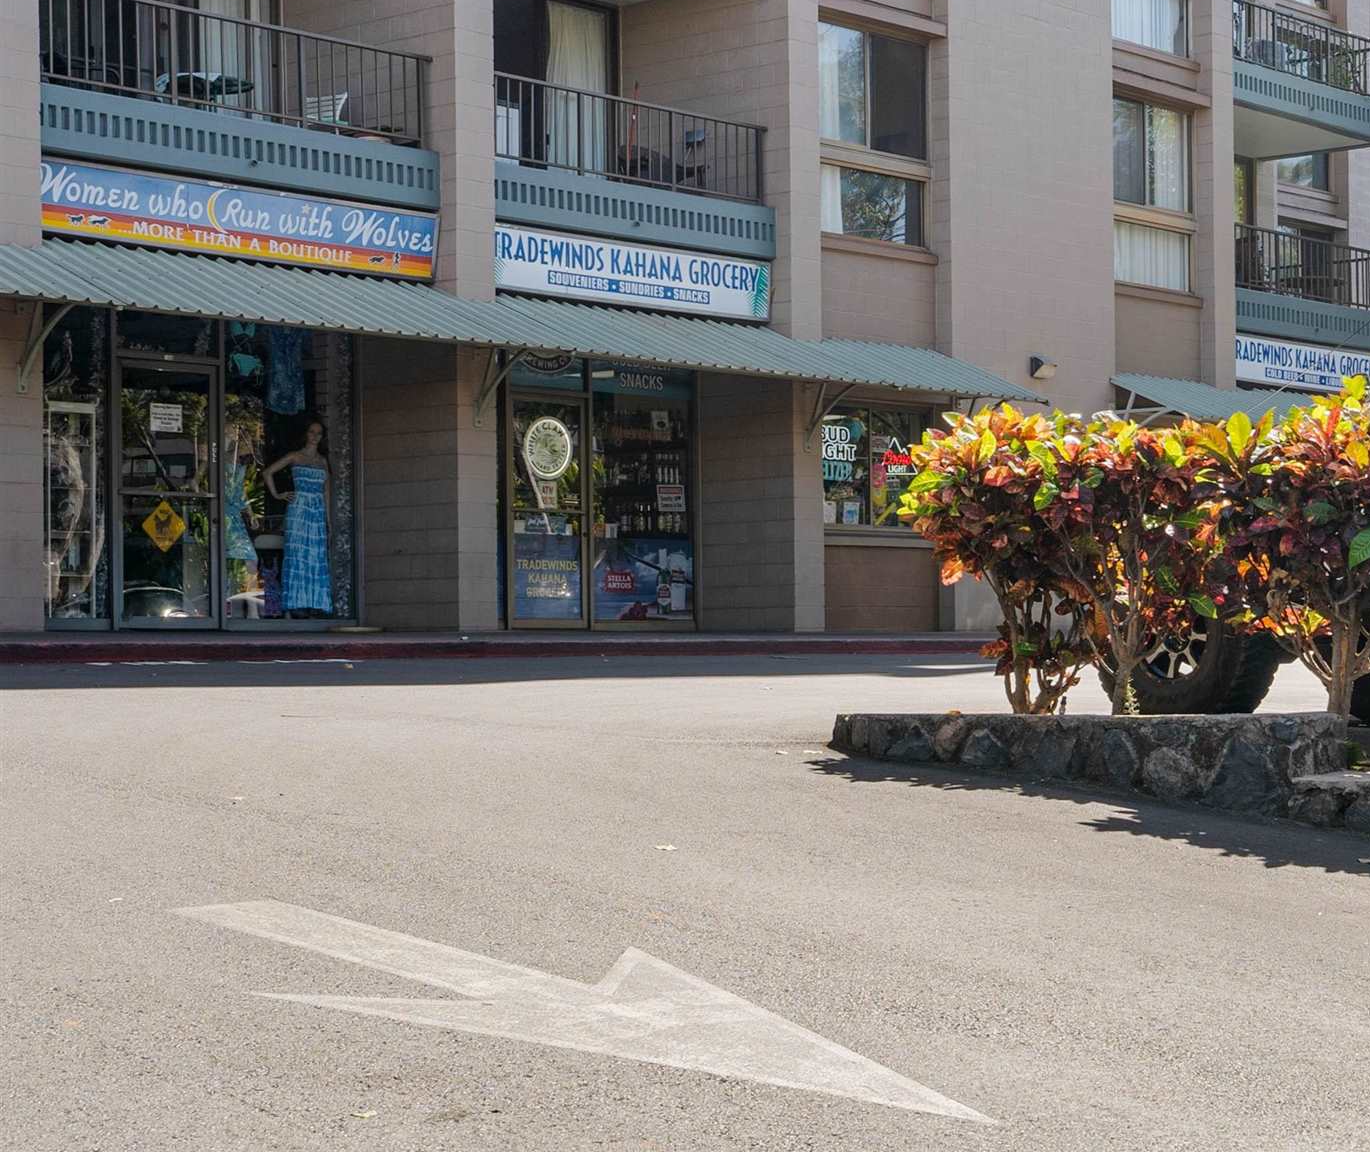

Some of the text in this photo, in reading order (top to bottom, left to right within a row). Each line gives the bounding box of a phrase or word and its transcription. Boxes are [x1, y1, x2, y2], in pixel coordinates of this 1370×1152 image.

[148, 184, 204, 220] who
[221, 199, 271, 230] Run
[278, 204, 334, 239] with
[341, 209, 434, 252] Wolves
[192, 228, 241, 250] THAN
[250, 238, 260, 251] A
[269, 239, 352, 265] BOUTIQUE
[549, 270, 710, 304] SOUVENIERS SUNDRIES SNACKS
[611, 248, 684, 283] KAHANA
[690, 258, 762, 292] GROCERY
[1235, 339, 1293, 367] RADEWINDS
[1295, 349, 1336, 374] KAHANA
[619, 372, 663, 391] SNACKS
[517, 559, 577, 571] TRADEWINDS
